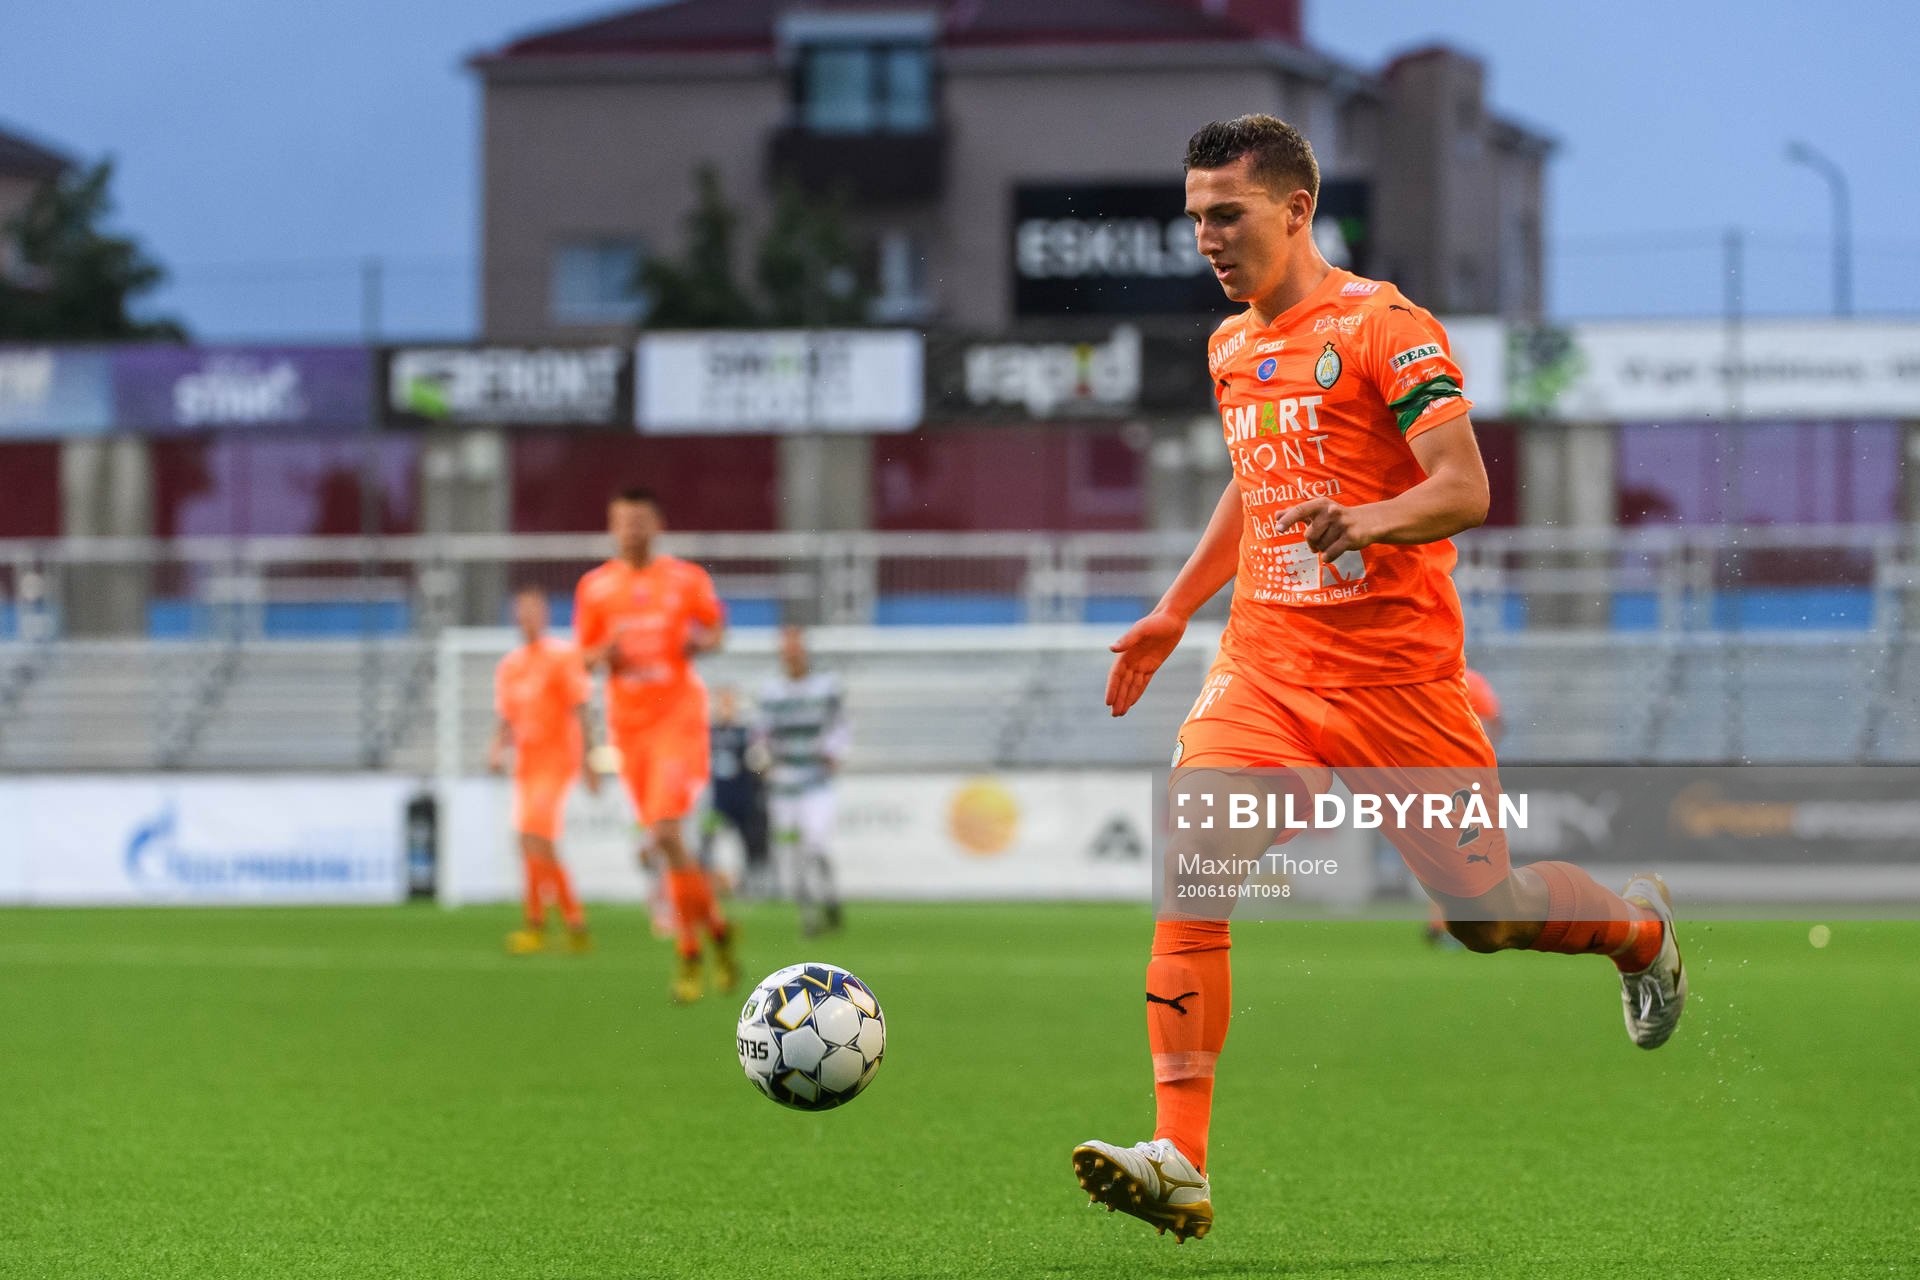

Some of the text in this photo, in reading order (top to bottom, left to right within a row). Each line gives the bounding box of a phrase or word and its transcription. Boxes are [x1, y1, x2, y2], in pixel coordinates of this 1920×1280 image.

[1398, 345, 1438, 366] PEAB
[1225, 395, 1323, 445] SMART
[1230, 434, 1329, 476] FRONT
[1241, 476, 1342, 514] parbanken
[736, 1036, 769, 1060] SELE
